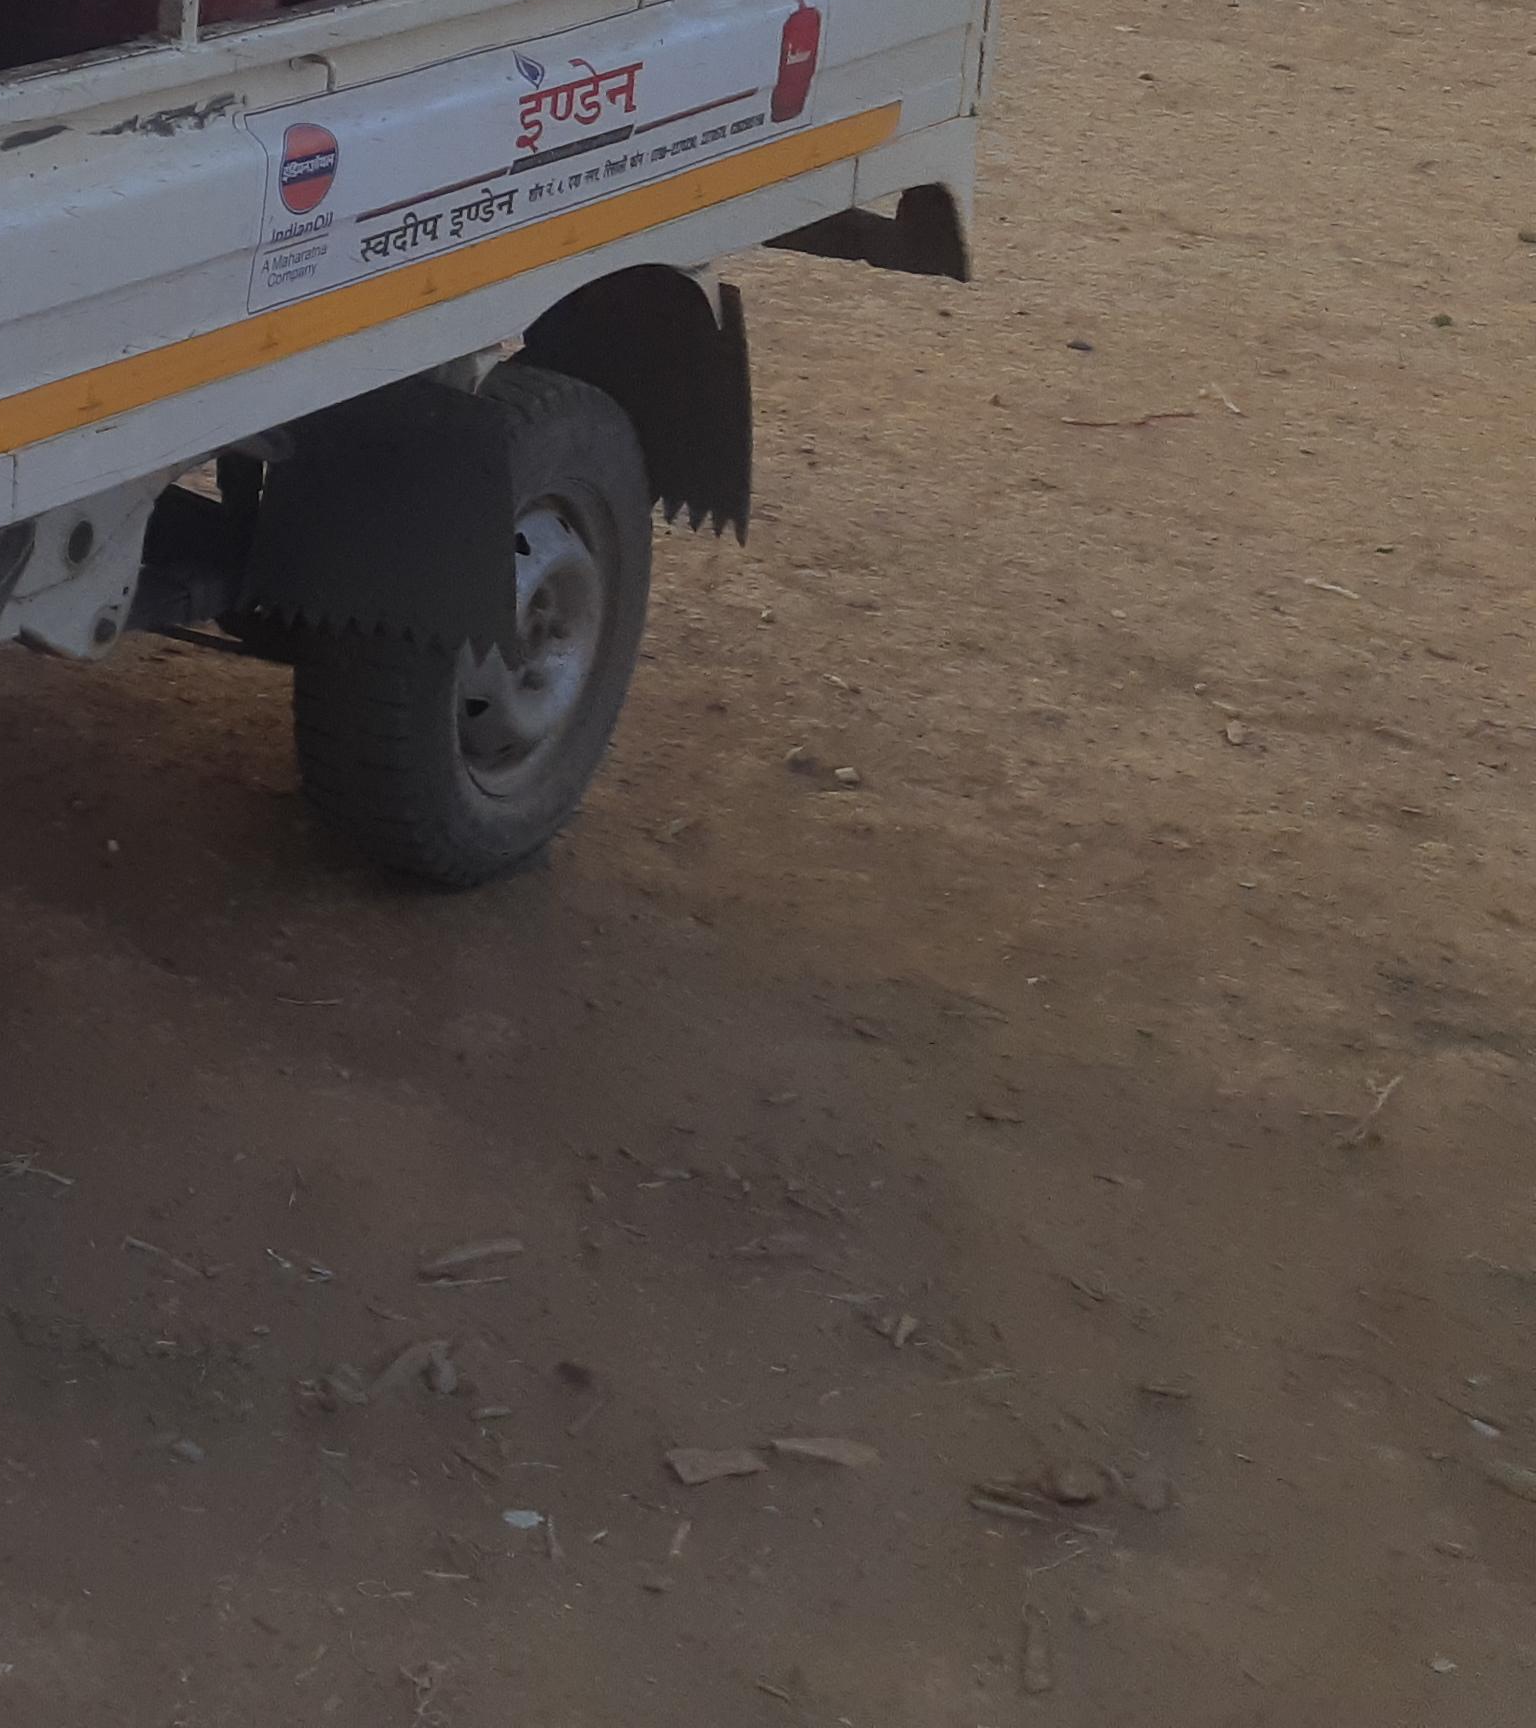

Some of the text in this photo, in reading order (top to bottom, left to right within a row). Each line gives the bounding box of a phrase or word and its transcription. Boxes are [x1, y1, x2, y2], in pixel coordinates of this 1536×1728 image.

[515, 58, 644, 153] इण्डेन
[271, 211, 334, 243] IndianOil
[360, 211, 444, 263] स्वदीप
[450, 188, 519, 239] इण्डेन
[272, 243, 328, 271] Maharatna
[267, 261, 318, 288] Company
